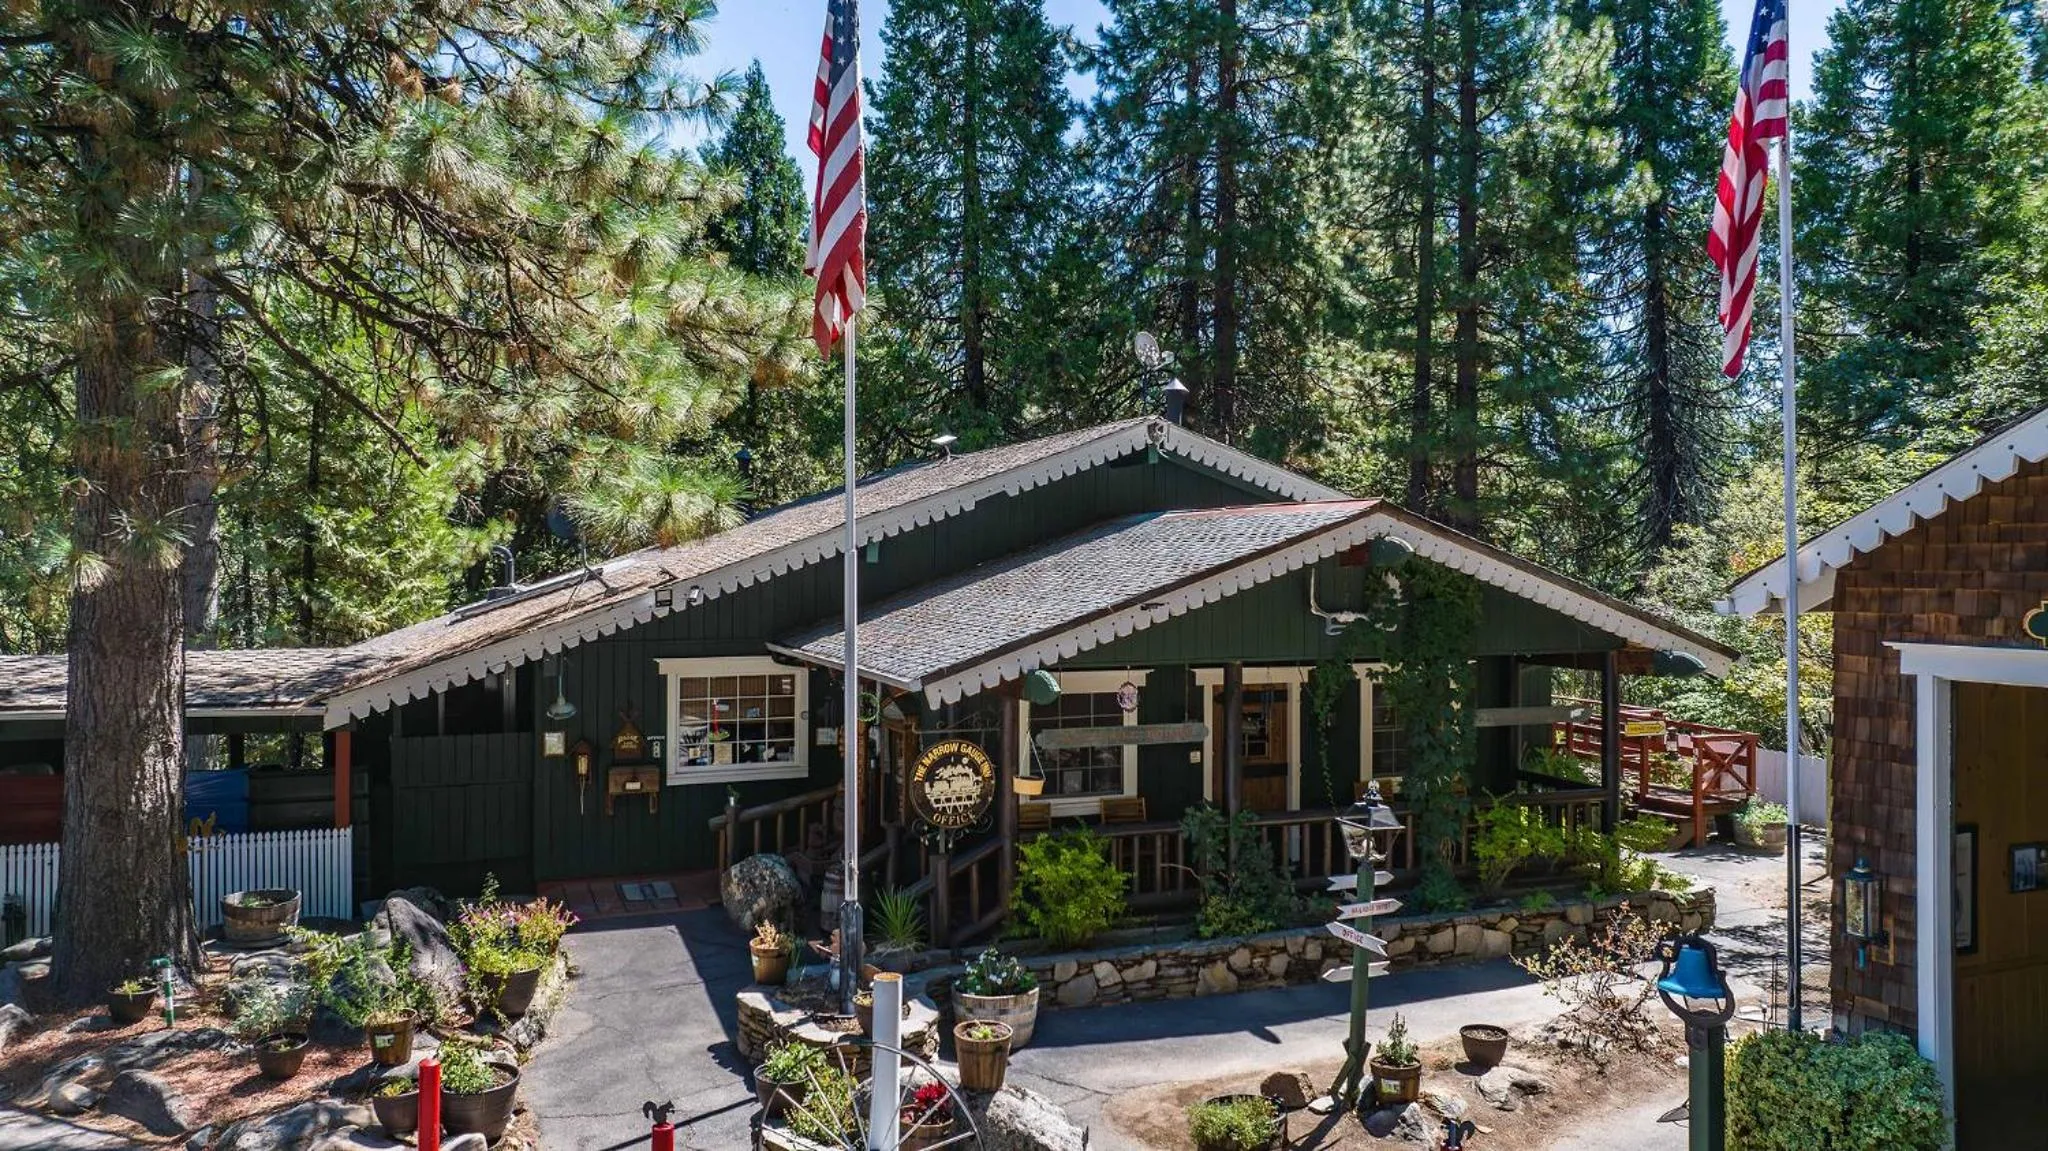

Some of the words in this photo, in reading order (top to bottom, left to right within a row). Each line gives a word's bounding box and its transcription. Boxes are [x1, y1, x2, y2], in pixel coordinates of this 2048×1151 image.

[914, 765, 927, 782] THE
[922, 742, 959, 766] NARROW
[960, 744, 985, 764] GAUGE
[980, 761, 992, 778] INN
[1342, 929, 1364, 944] OFFICE
